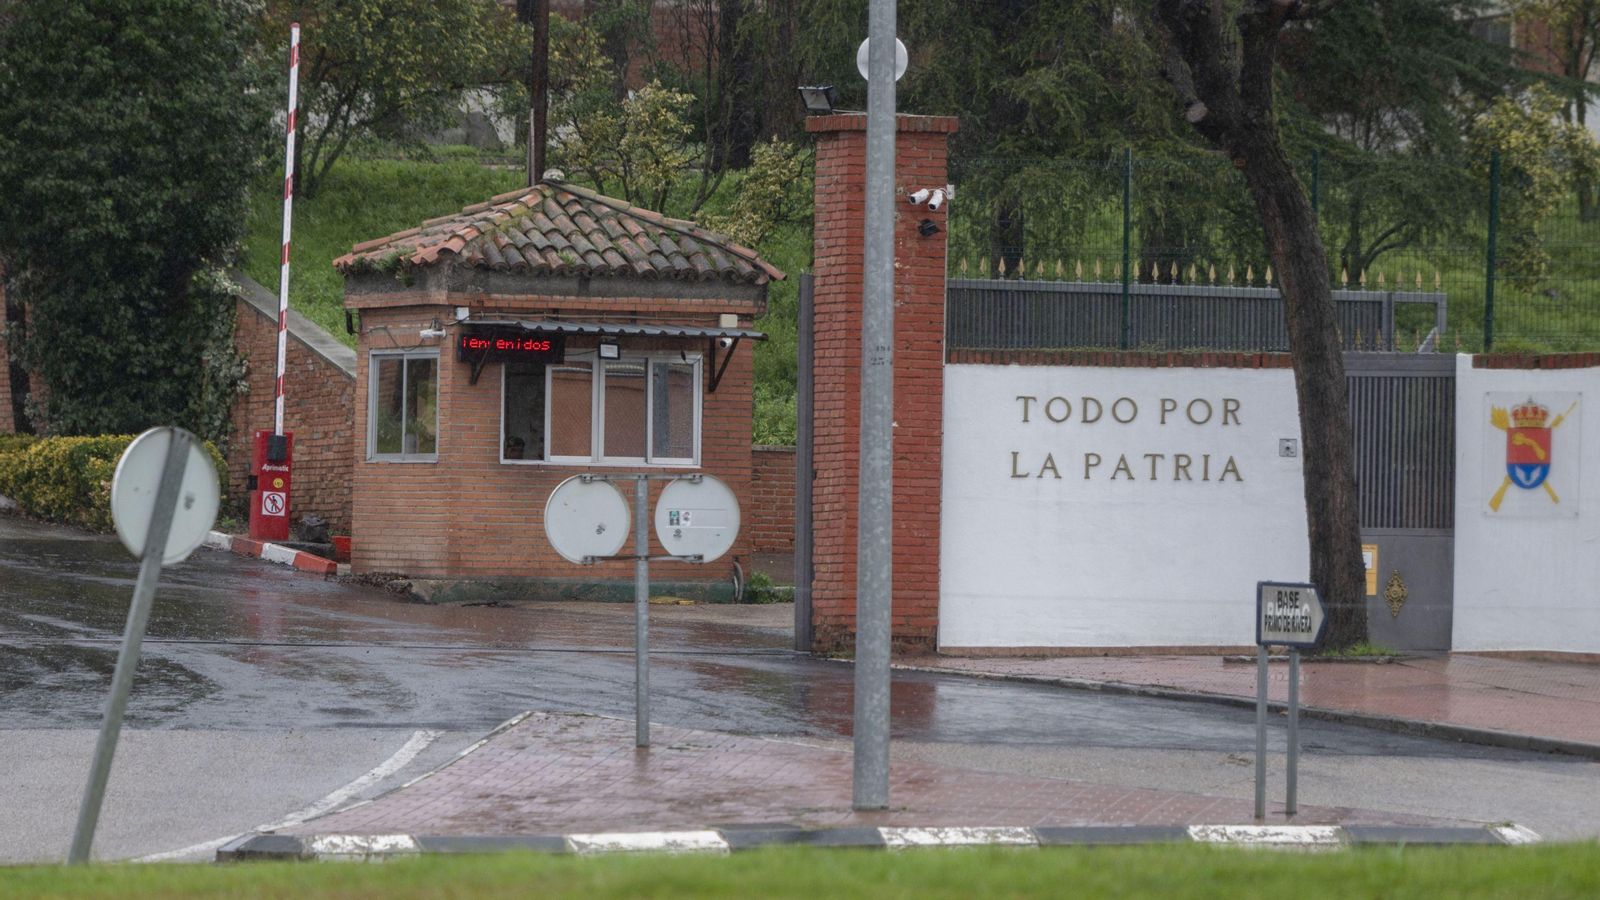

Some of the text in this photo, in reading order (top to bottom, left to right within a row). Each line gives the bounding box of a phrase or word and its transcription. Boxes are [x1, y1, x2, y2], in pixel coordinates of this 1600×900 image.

[462, 337, 551, 350] ienenidos
[1016, 396, 1242, 425] TODO POR
[1010, 451, 1244, 481] LA PATRIA
[1277, 591, 1299, 609] BASE
[1283, 615, 1291, 633] DE
